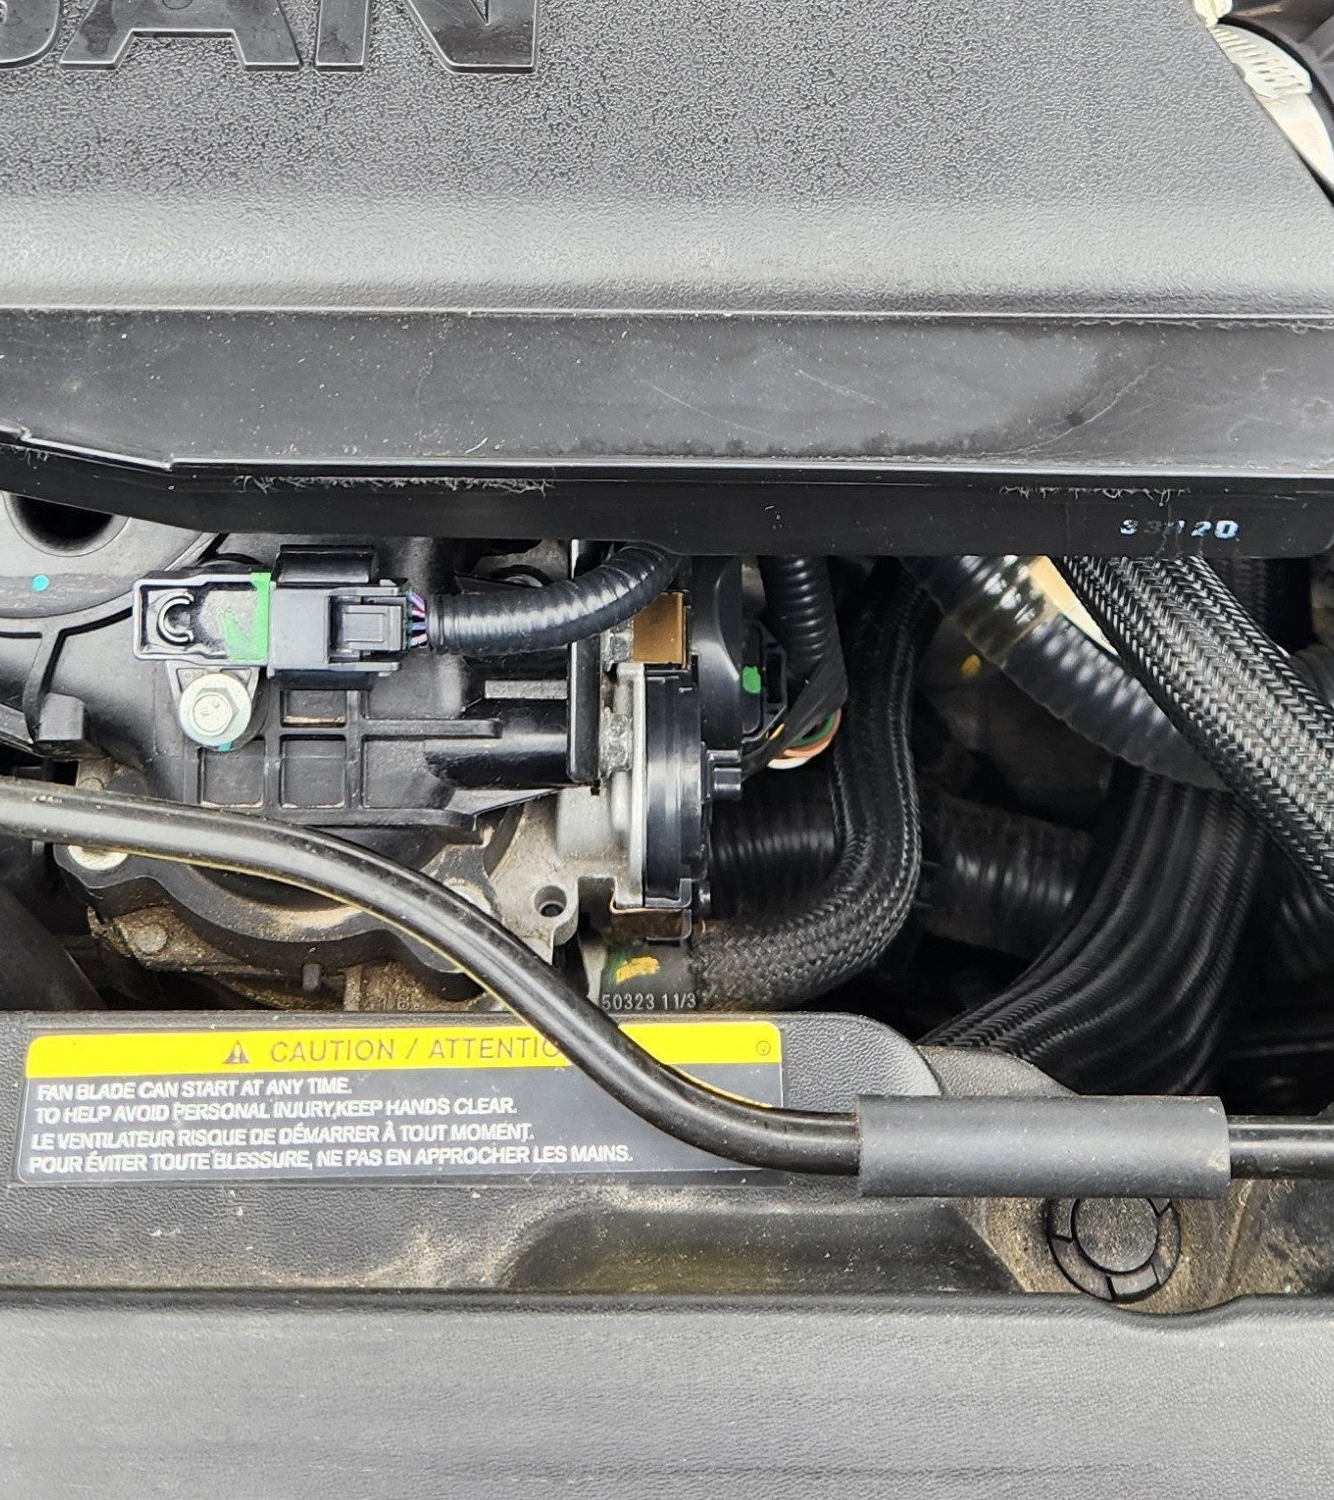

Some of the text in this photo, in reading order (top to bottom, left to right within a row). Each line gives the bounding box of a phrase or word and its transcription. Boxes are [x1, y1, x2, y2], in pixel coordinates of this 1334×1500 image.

[601, 992, 655, 1011] 50323
[270, 1038, 395, 1063] CAUTION
[428, 1036, 563, 1060] ATTENTIO
[37, 1077, 352, 1101] FAN BLADE CAN START AT ANY TIME.
[34, 1107, 60, 1124] TO
[63, 1105, 112, 1124] HELP
[112, 1104, 169, 1123] AVOID
[172, 1101, 270, 1121] PERSONAL
[386, 1098, 451, 1116] HANDS
[454, 1097, 517, 1115] CLEAR.
[31, 1120, 535, 1150] LE VENTILATEUR RISQUE DE DÉMARRER À TOUT MOMENT.
[27, 1144, 634, 1173] POUR ÉVITER TOUTE BLESSURE, NE PAS EN APPROCHER LES MAINS.
